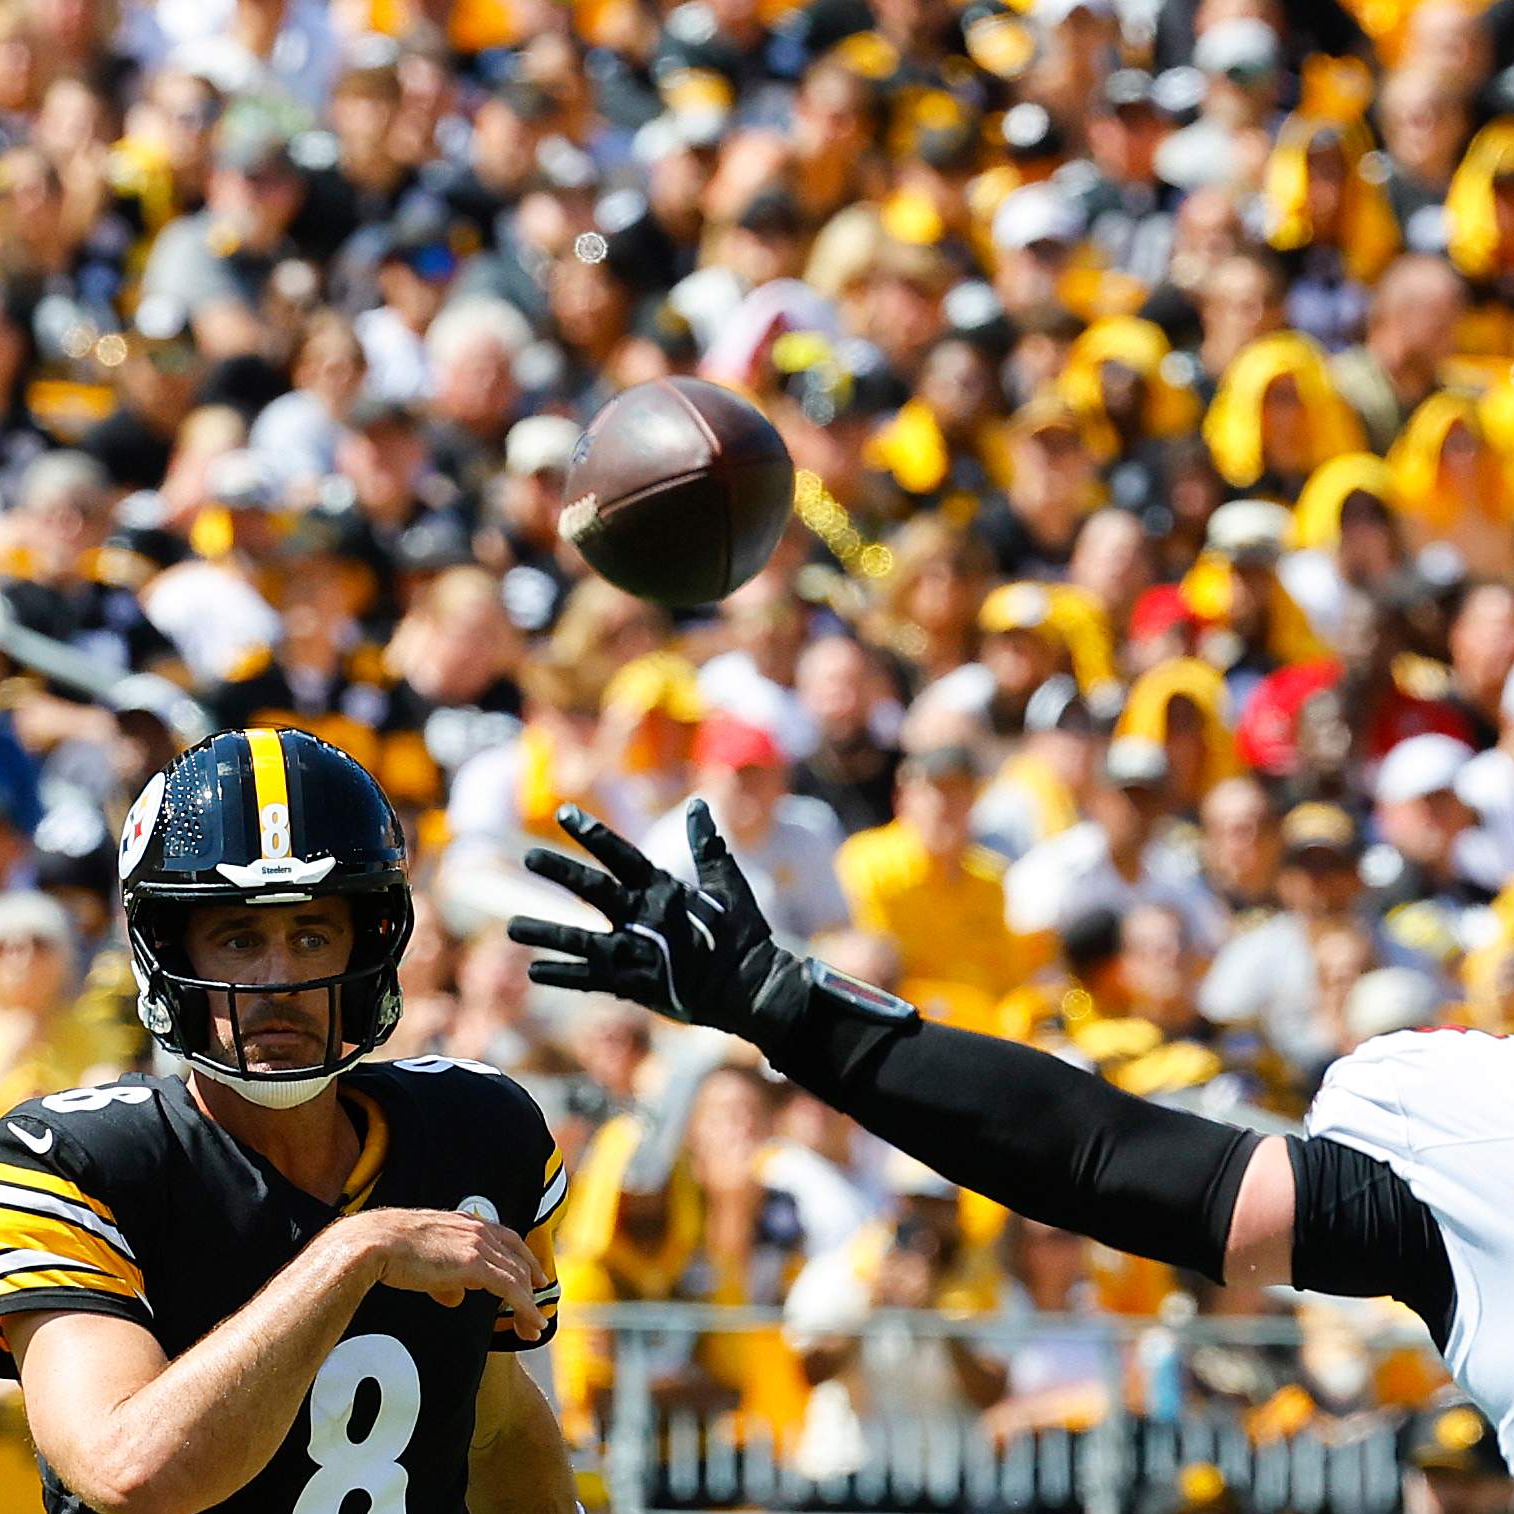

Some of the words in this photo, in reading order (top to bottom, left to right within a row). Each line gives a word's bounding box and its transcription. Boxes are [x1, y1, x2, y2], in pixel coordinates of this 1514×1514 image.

[261, 803, 290, 858] 8
[261, 865, 292, 875] Steelers
[41, 1086, 153, 1113] 8
